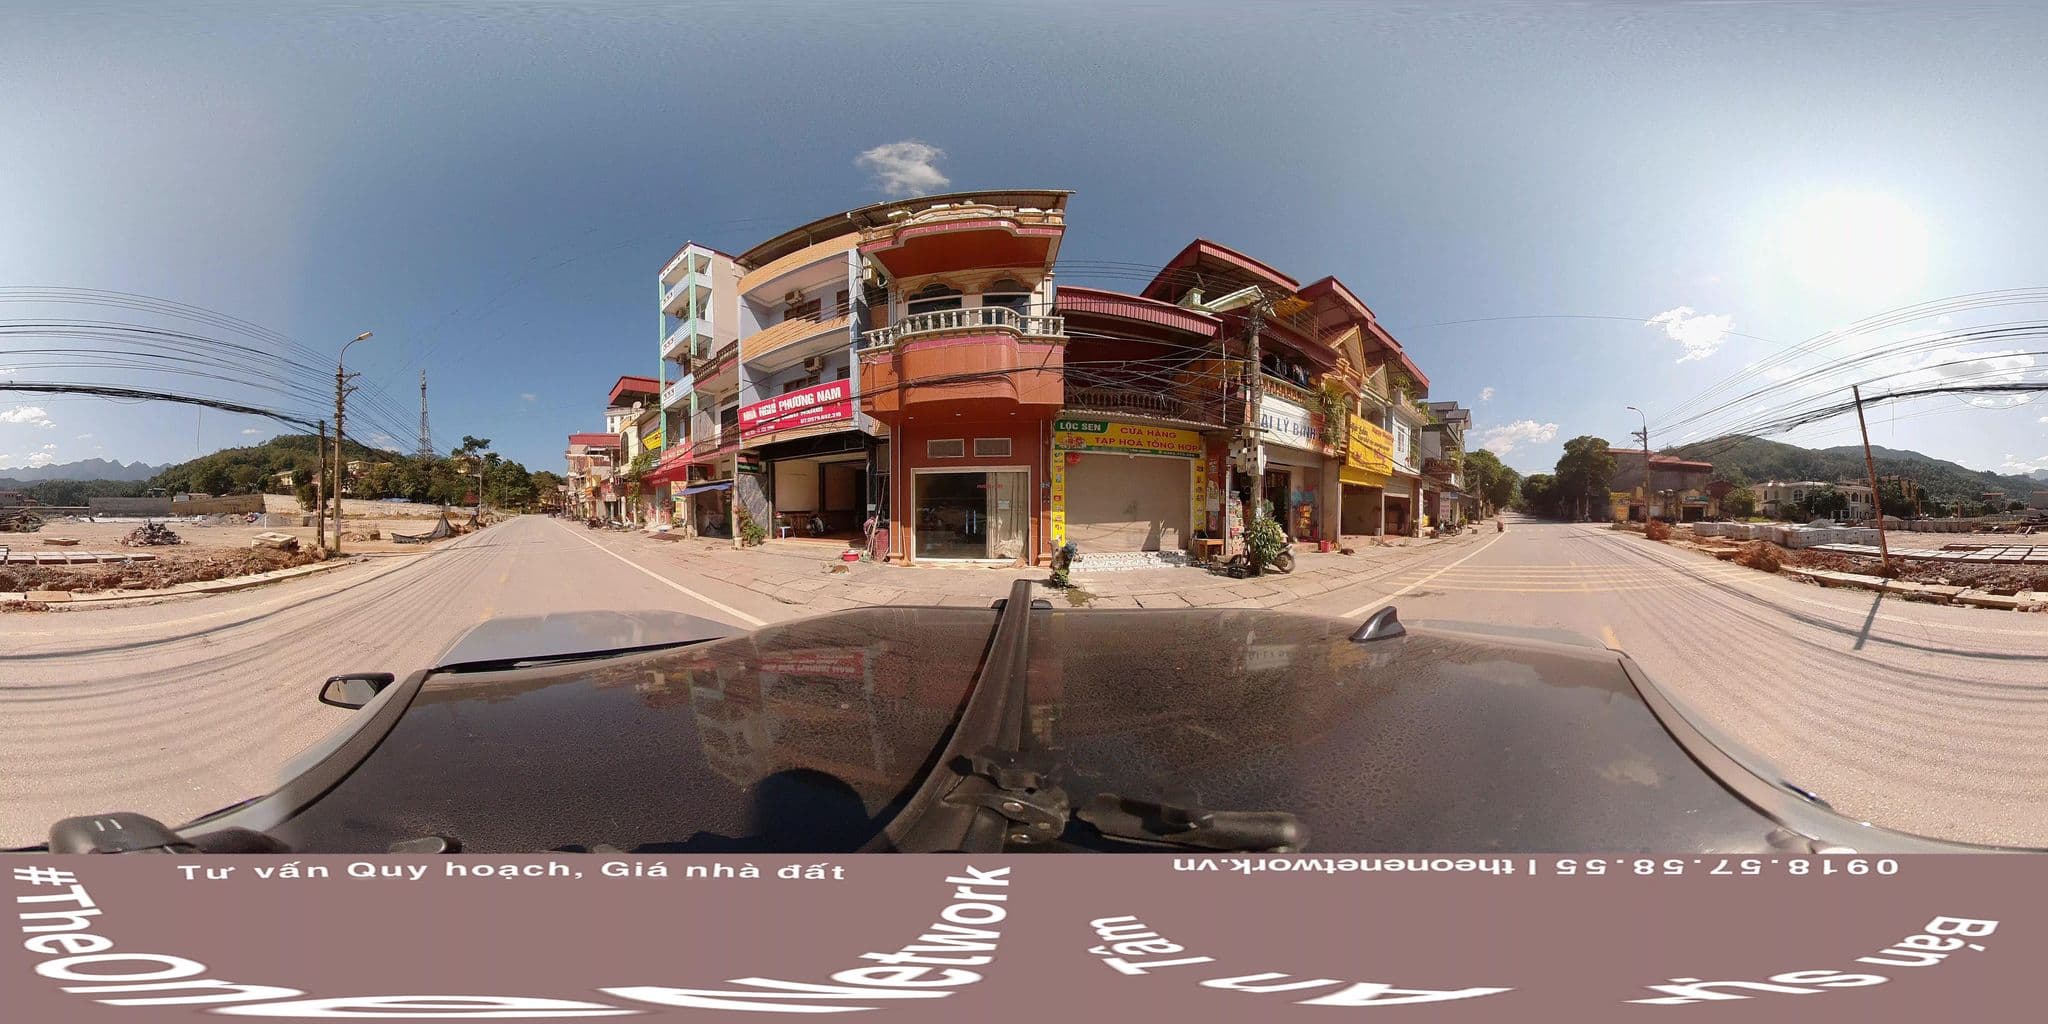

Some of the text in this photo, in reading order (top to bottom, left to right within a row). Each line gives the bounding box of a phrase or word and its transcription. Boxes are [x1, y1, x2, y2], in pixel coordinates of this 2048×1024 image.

[816, 386, 841, 402] NAM
[1060, 422, 1101, 432] LỘC SEN
[1120, 426, 1177, 439] CỬA HÀNG
[1095, 436, 1116, 446] TẠP
[1146, 439, 1174, 449] TỔNG
[1178, 443, 1199, 452] HỢP
